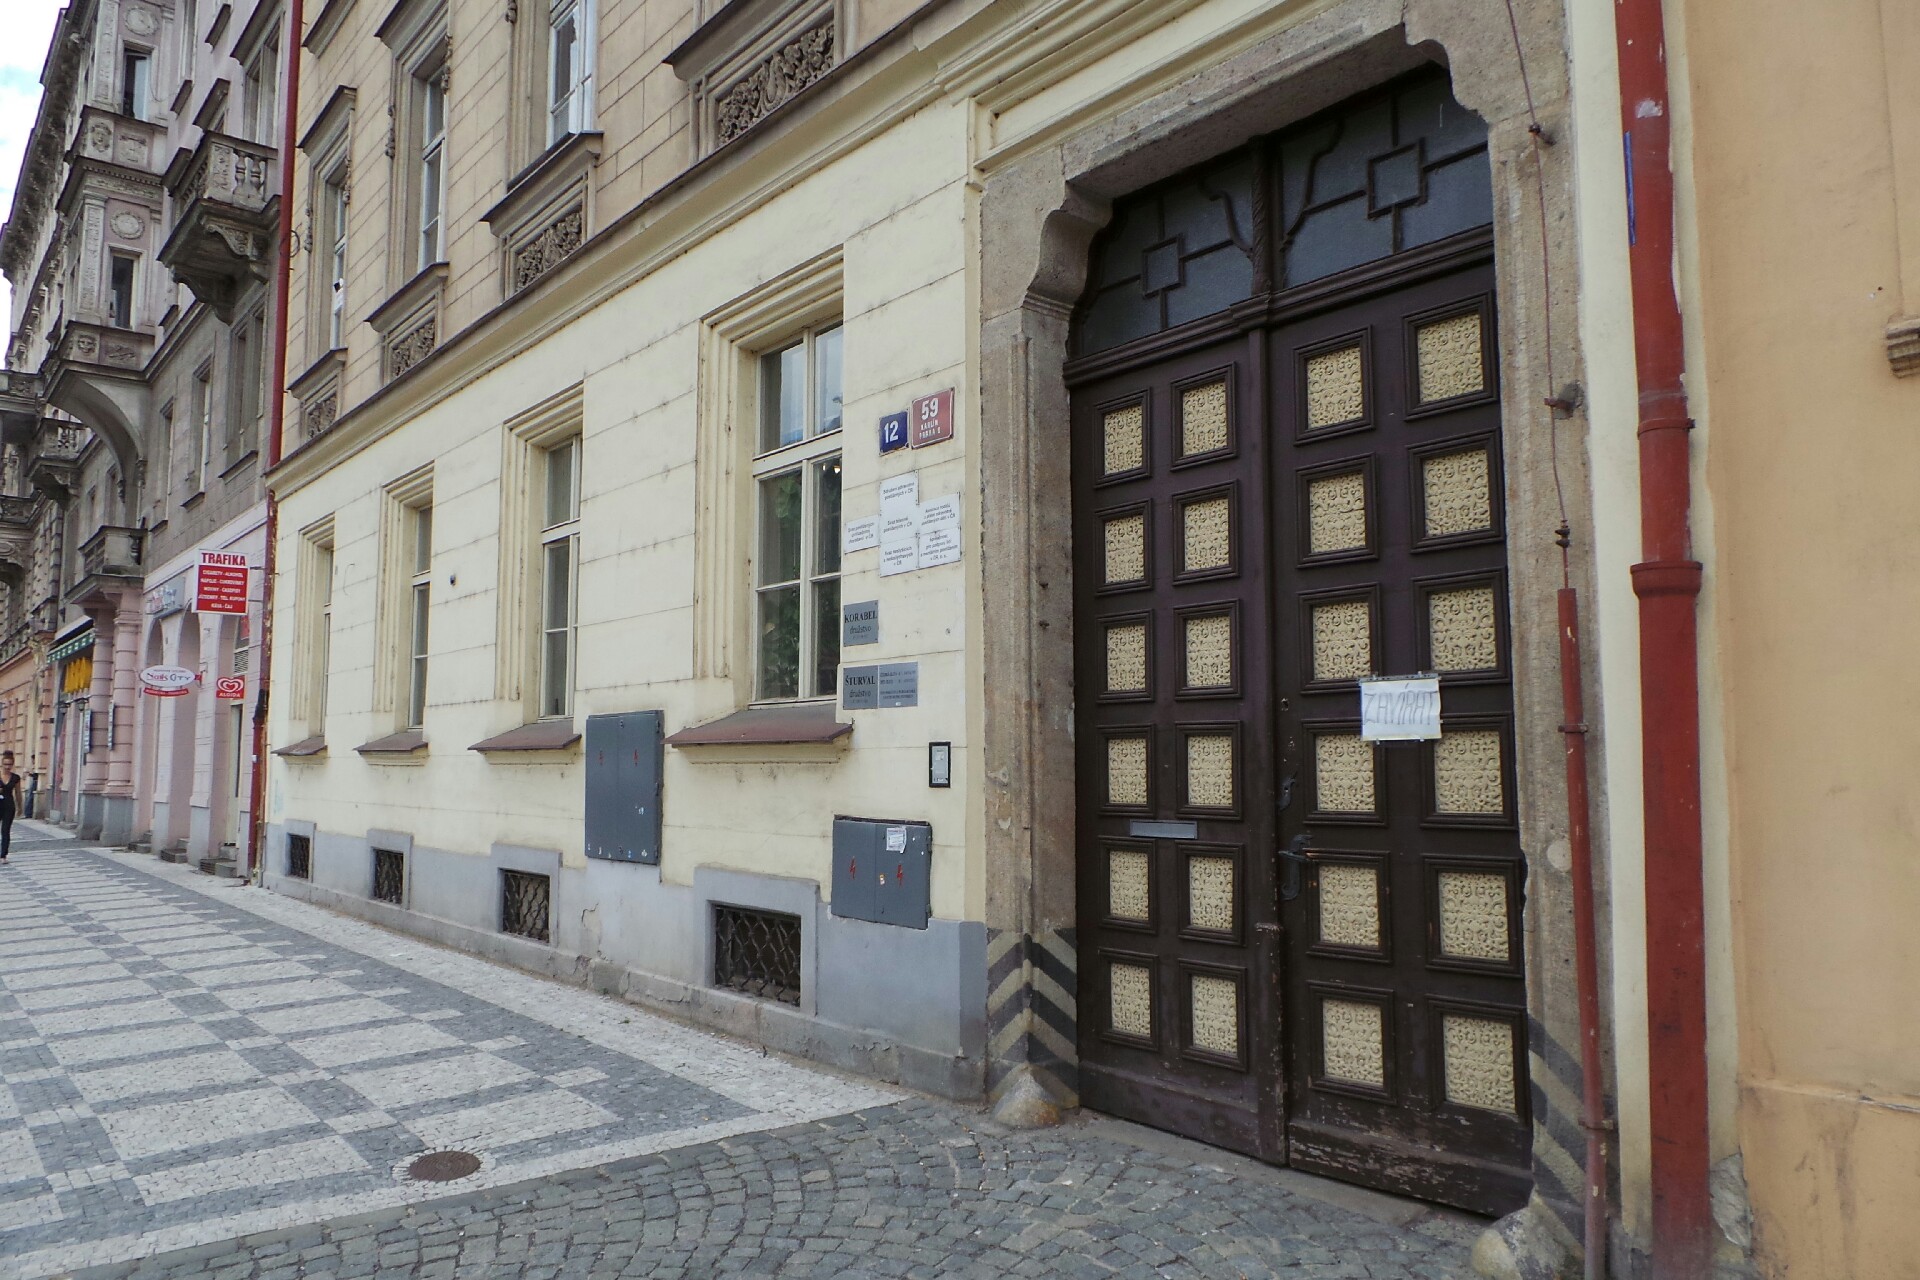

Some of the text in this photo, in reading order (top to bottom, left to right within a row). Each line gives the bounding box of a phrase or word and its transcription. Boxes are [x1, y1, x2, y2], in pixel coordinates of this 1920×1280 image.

[922, 398, 938, 420] 59
[921, 418, 938, 430] KARLÍN
[884, 420, 899, 444] 12
[201, 552, 246, 566] TRAFIKA
[845, 610, 878, 624] KORABEL
[845, 675, 876, 686] ŠTURVAL
